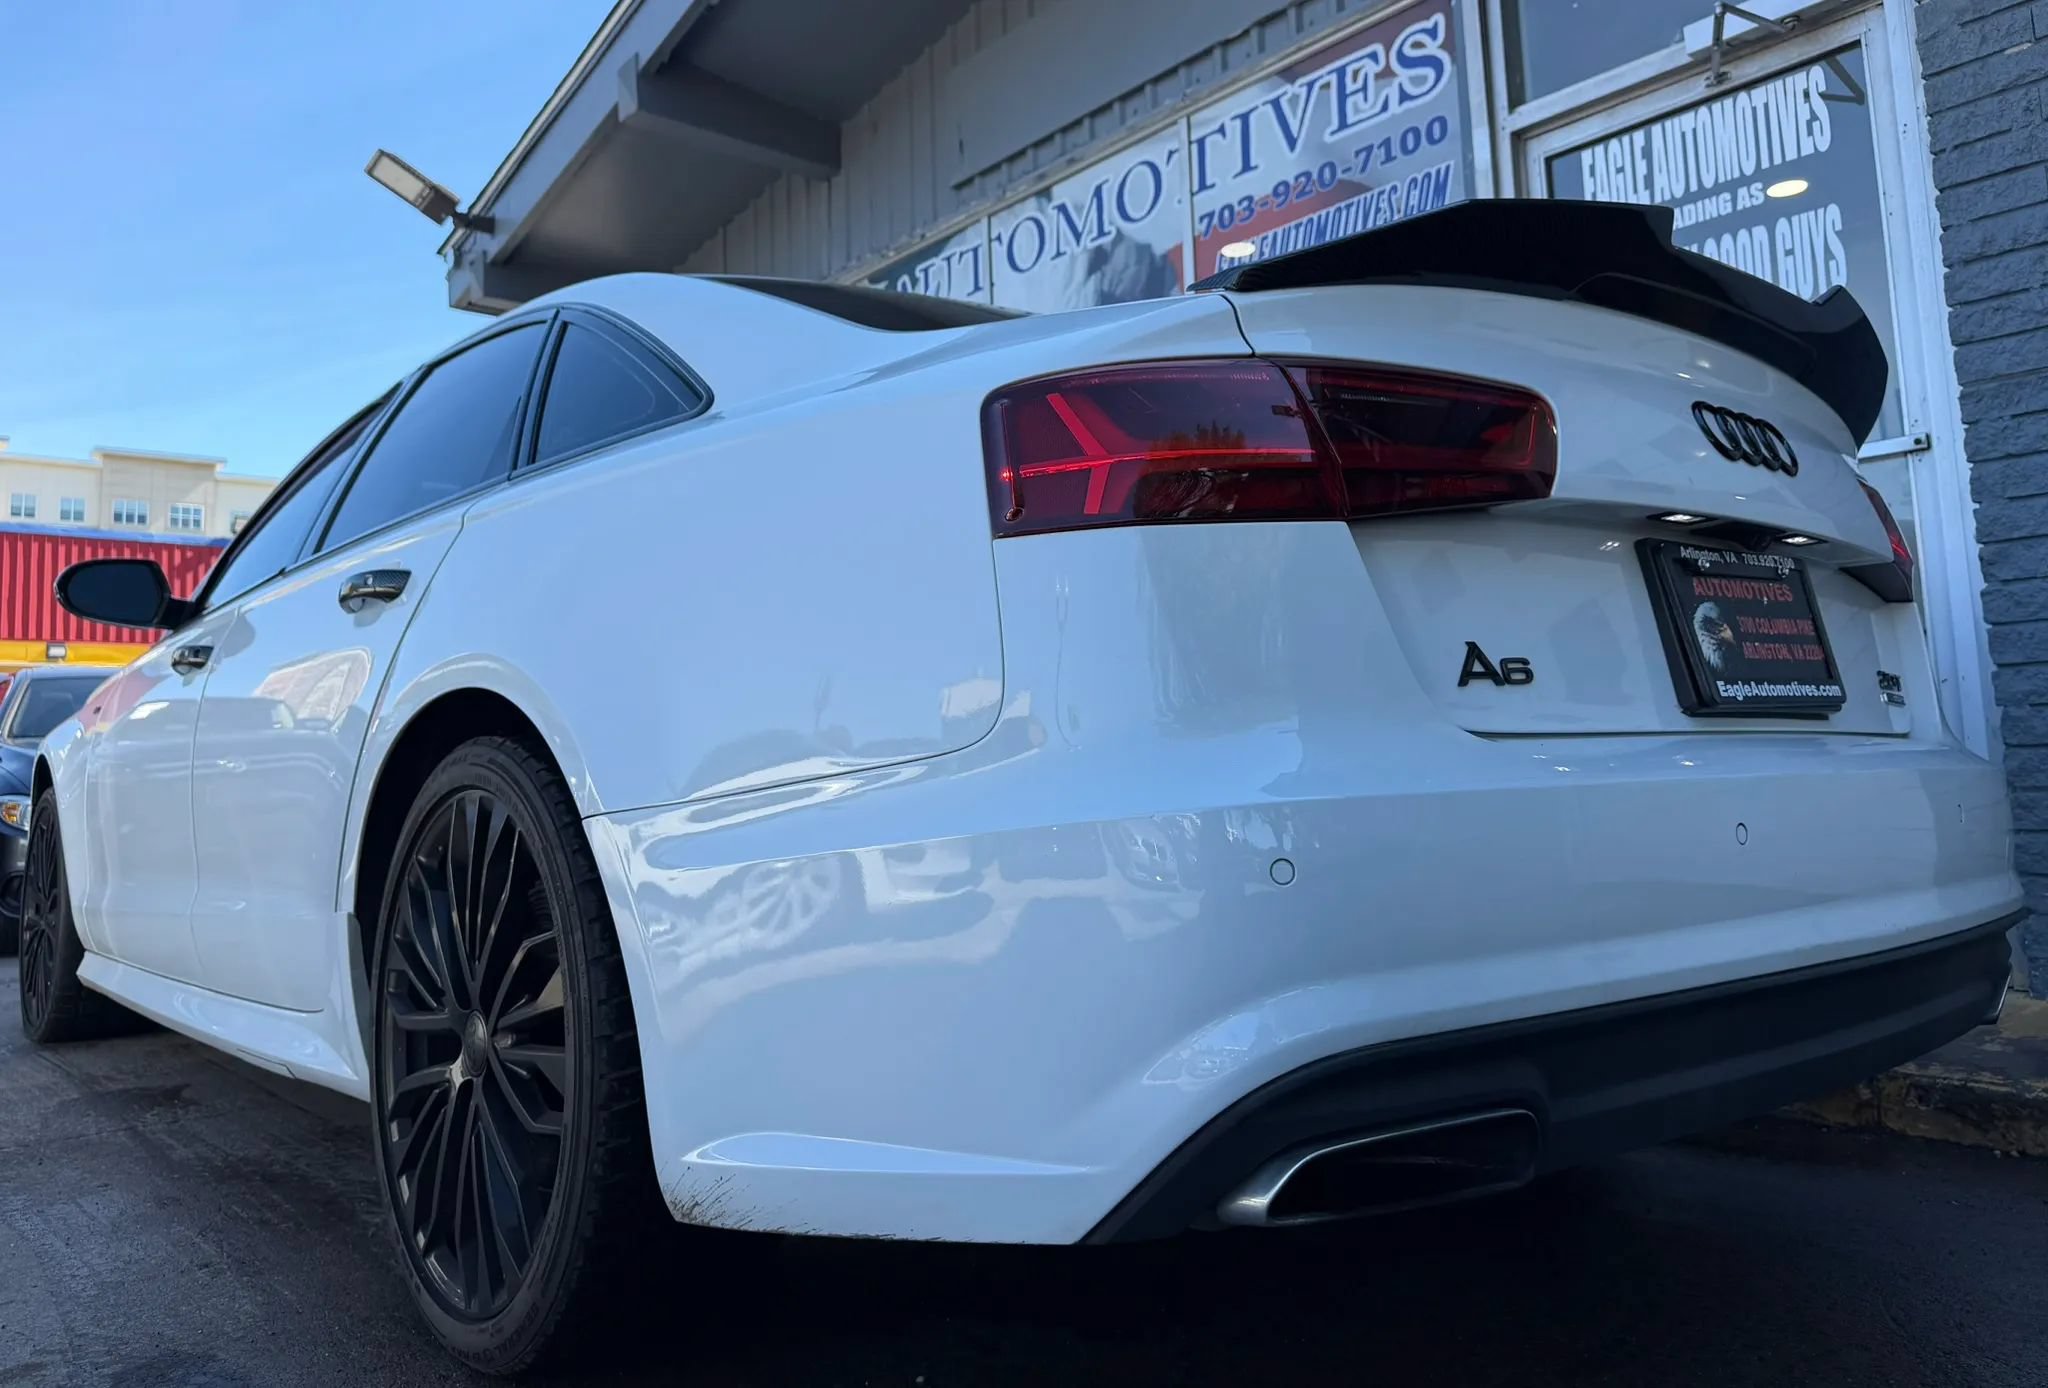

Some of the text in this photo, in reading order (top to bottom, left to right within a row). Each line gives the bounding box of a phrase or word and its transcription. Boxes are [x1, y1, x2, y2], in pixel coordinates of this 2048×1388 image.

[898, 13, 1446, 297] UTOMOTIVES
[1581, 65, 1832, 204] EAGLE AUTOMOTIVES
[1199, 116, 1448, 238] 703-920-7100
[1673, 182, 1765, 230] ADING AS
[1775, 203, 1848, 299] GUYS
[1680, 546, 1724, 565] Arlington,
[1723, 551, 1738, 564] VA
[1692, 577, 1793, 602] AUTOMOTIVES
[1457, 640, 1534, 687] A6
[1716, 680, 1842, 701] EagleAutomotives.com
